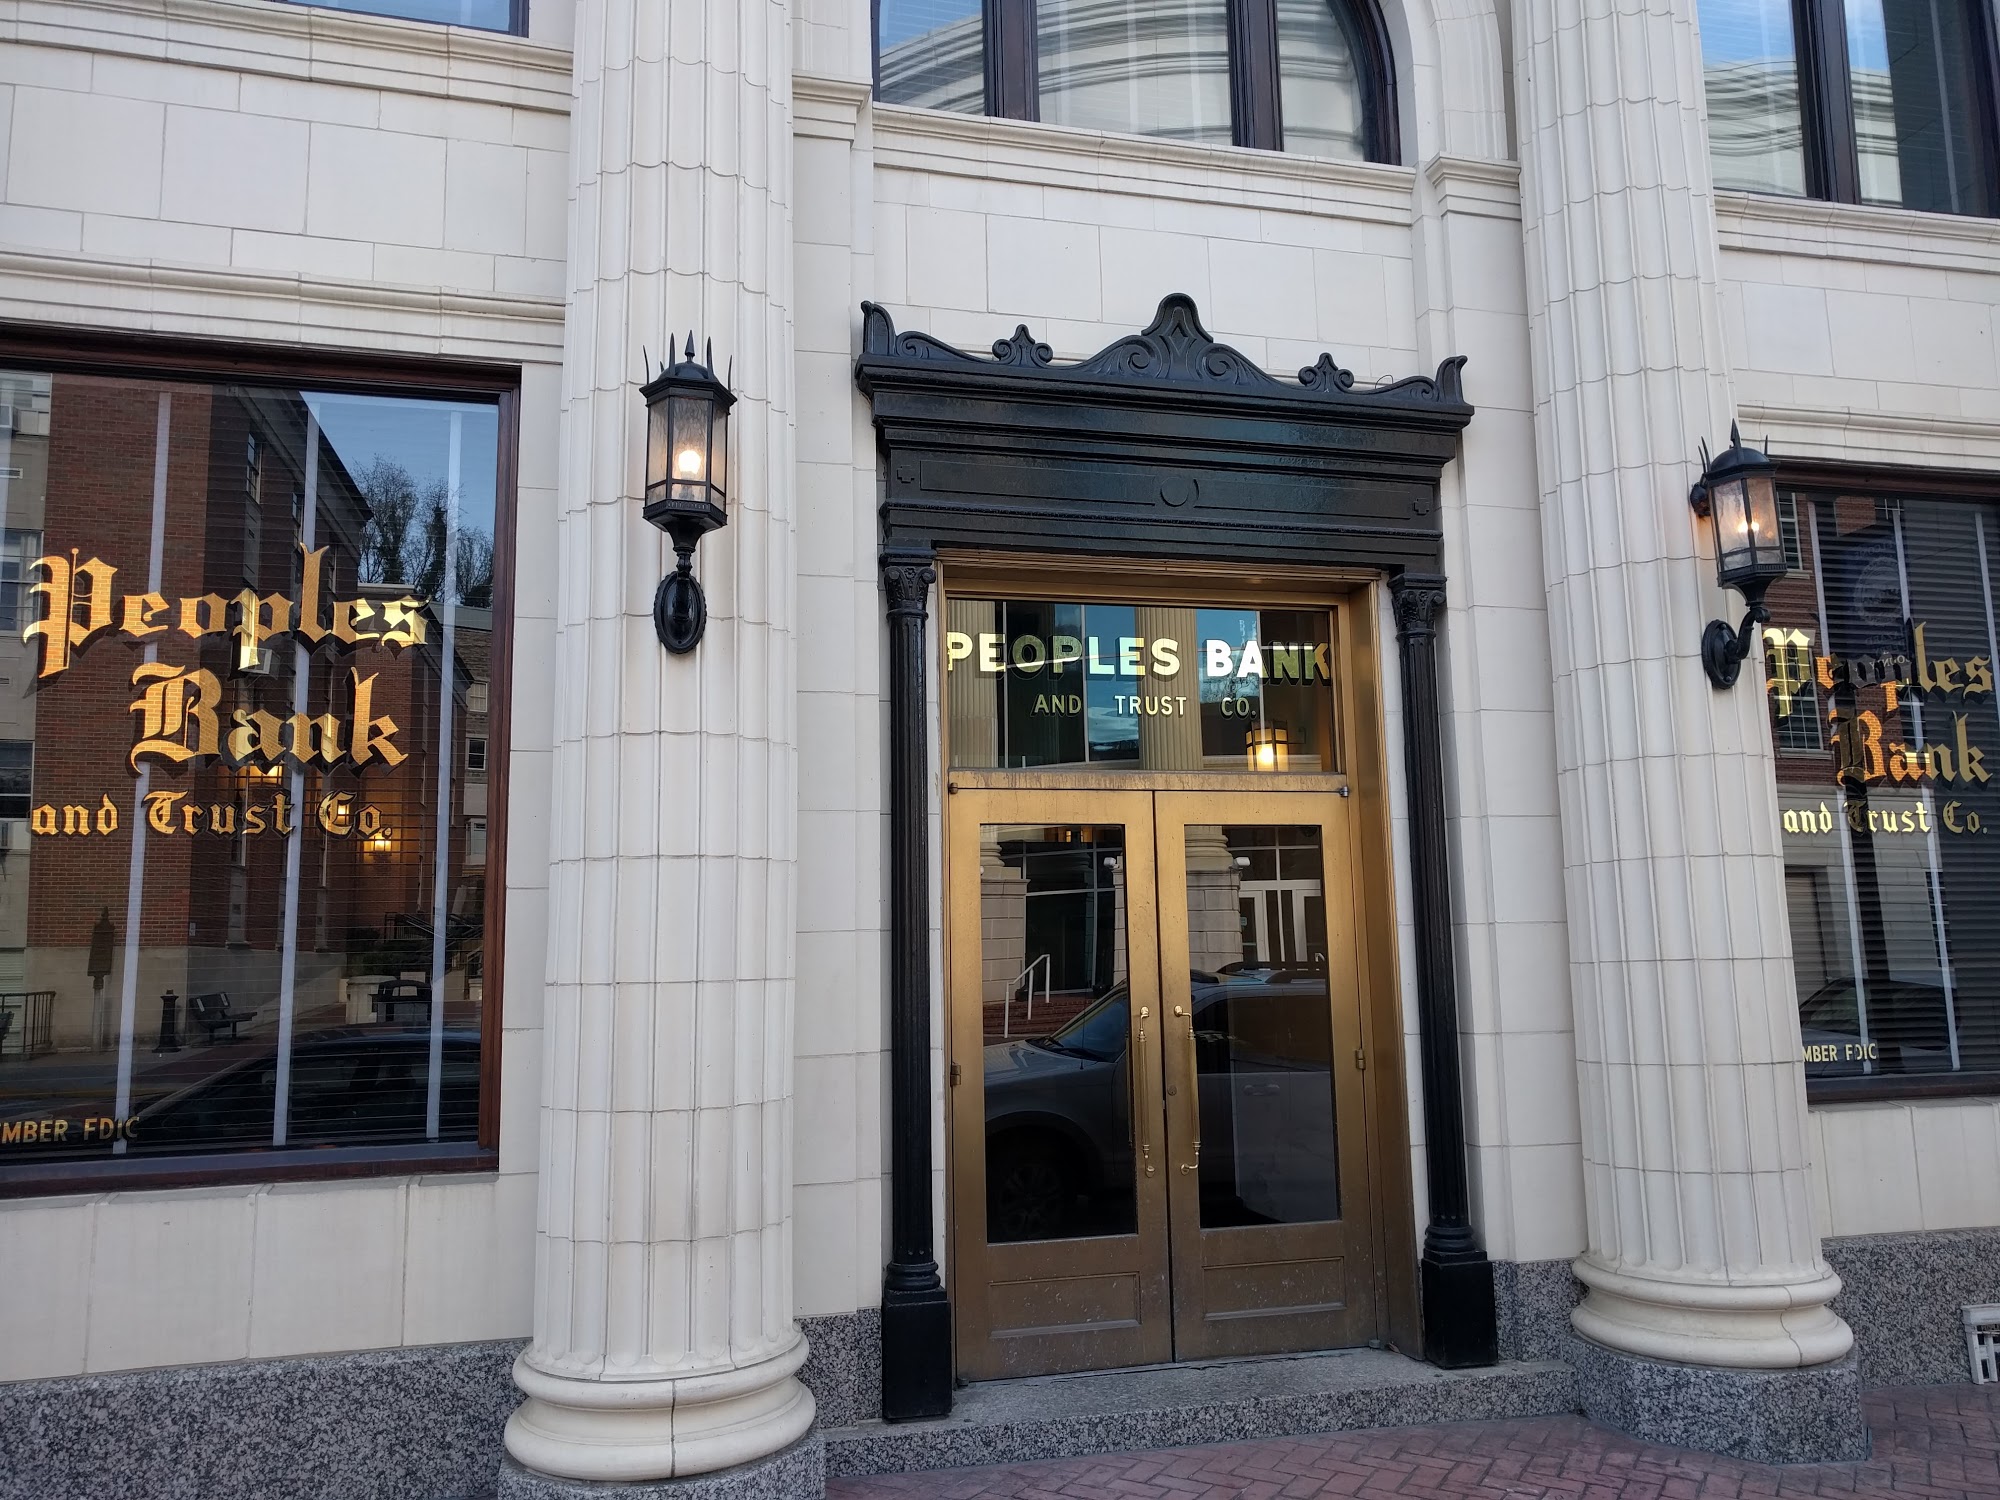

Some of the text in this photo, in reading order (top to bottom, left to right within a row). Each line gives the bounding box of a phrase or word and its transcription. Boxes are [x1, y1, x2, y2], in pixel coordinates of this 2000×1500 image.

[23, 543, 430, 678] Peoples
[947, 632, 1331, 679] PEOPLES BANK
[1763, 621, 1993, 718] Peoples
[129, 662, 408, 774] Bank
[1034, 693, 1257, 716] AND TRUST CO.
[1828, 709, 1993, 787] Bank
[32, 790, 393, 837] and Trust Co.
[1783, 800, 1988, 834] and Trust Co.
[1845, 1043, 1877, 1061] FDIC
[0, 1116, 140, 1144] MBER FDIC
